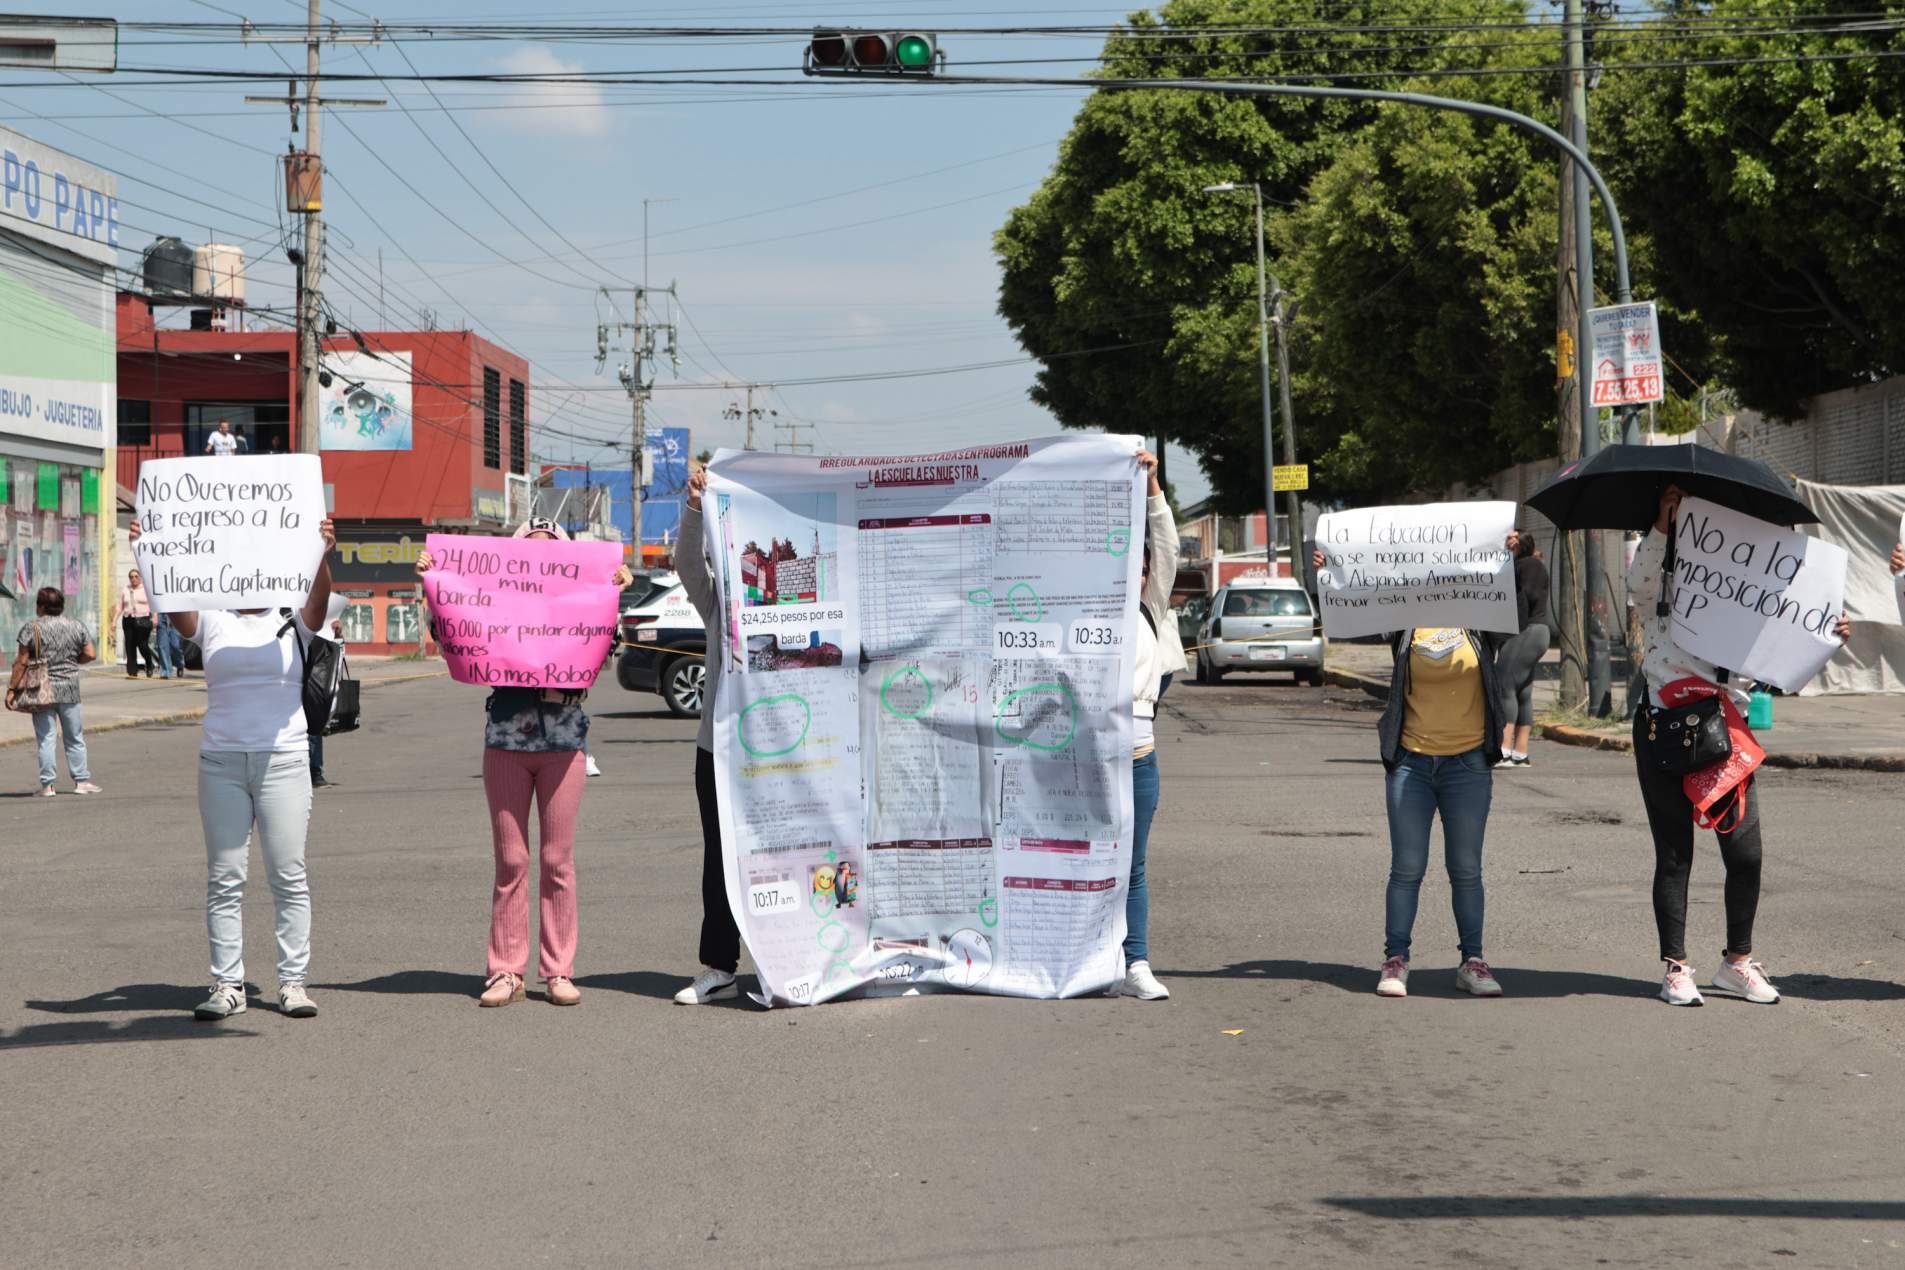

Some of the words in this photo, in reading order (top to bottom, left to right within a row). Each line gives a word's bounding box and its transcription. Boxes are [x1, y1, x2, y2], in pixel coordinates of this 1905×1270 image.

[3, 151, 41, 220] PO
[55, 172, 119, 249] PAPE
[44, 400, 103, 433] JUGUETERIA
[977, 443, 1030, 461] PROGRAMA
[868, 469, 882, 483] LA
[881, 466, 922, 483] ESCUELA
[922, 465, 936, 482] ES
[935, 463, 980, 481] NUESTRA
[141, 475, 172, 505] No
[175, 472, 293, 503] Queremos
[141, 509, 163, 533] de
[171, 509, 245, 538] regreso
[251, 509, 268, 528] a
[279, 506, 300, 530] la
[1327, 519, 1349, 544] La
[138, 533, 216, 557] maestra
[1678, 512, 1725, 554] No
[1731, 541, 1756, 568] a
[1764, 540, 1803, 586] la
[506, 559, 530, 575] en
[540, 561, 580, 581] una
[1347, 551, 1364, 565] se
[1375, 550, 1425, 569] negocia
[150, 563, 214, 596] Liliana
[499, 577, 544, 594] mini
[1320, 571, 1332, 585] a
[1349, 568, 1421, 593] Alejandro
[1425, 569, 1494, 586] Armenta
[436, 581, 492, 608] barda
[1673, 587, 1709, 619] EP
[741, 612, 779, 625] $24,256
[780, 612, 808, 625] pesos
[809, 610, 824, 621] por
[827, 609, 844, 619] esa
[1802, 602, 1841, 642] de
[487, 624, 510, 644] por
[517, 623, 568, 644] pintar
[781, 632, 807, 645] barda
[998, 631, 1037, 648] 10:33
[1075, 627, 1112, 645] 10:33
[505, 667, 540, 686] mas
[544, 662, 599, 684] Robos
[753, 890, 778, 908] 10:17
